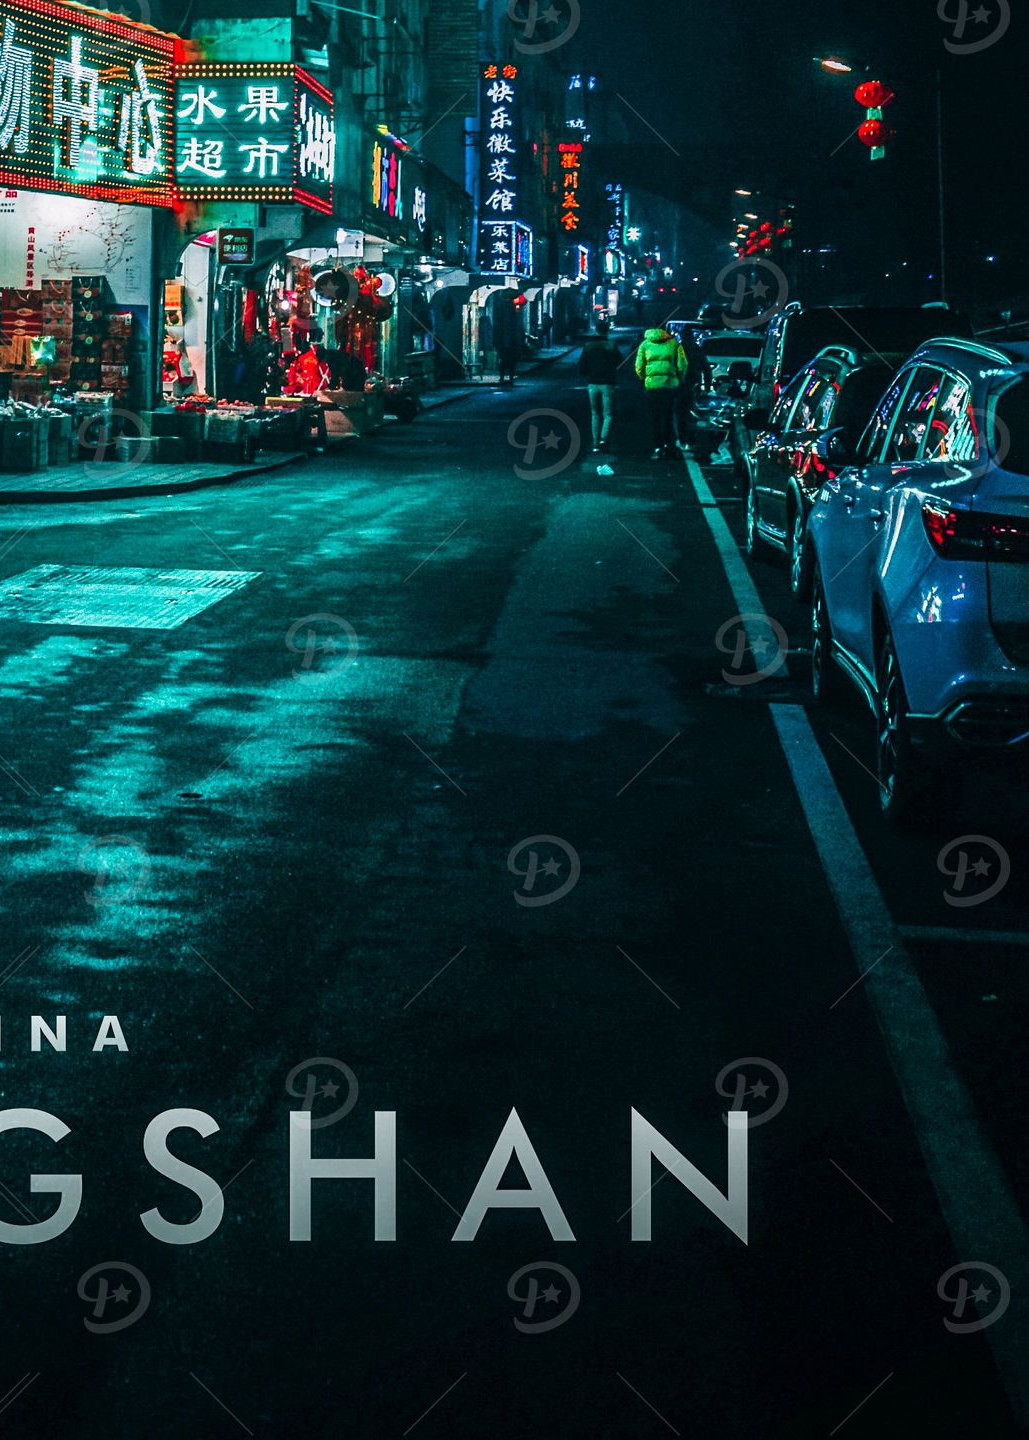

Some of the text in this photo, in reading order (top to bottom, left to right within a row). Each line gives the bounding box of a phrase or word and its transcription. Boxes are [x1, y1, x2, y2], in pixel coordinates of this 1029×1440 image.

[483, 64, 518, 79] 老街
[177, 83, 290, 126] 水果
[176, 136, 290, 179] 超市
